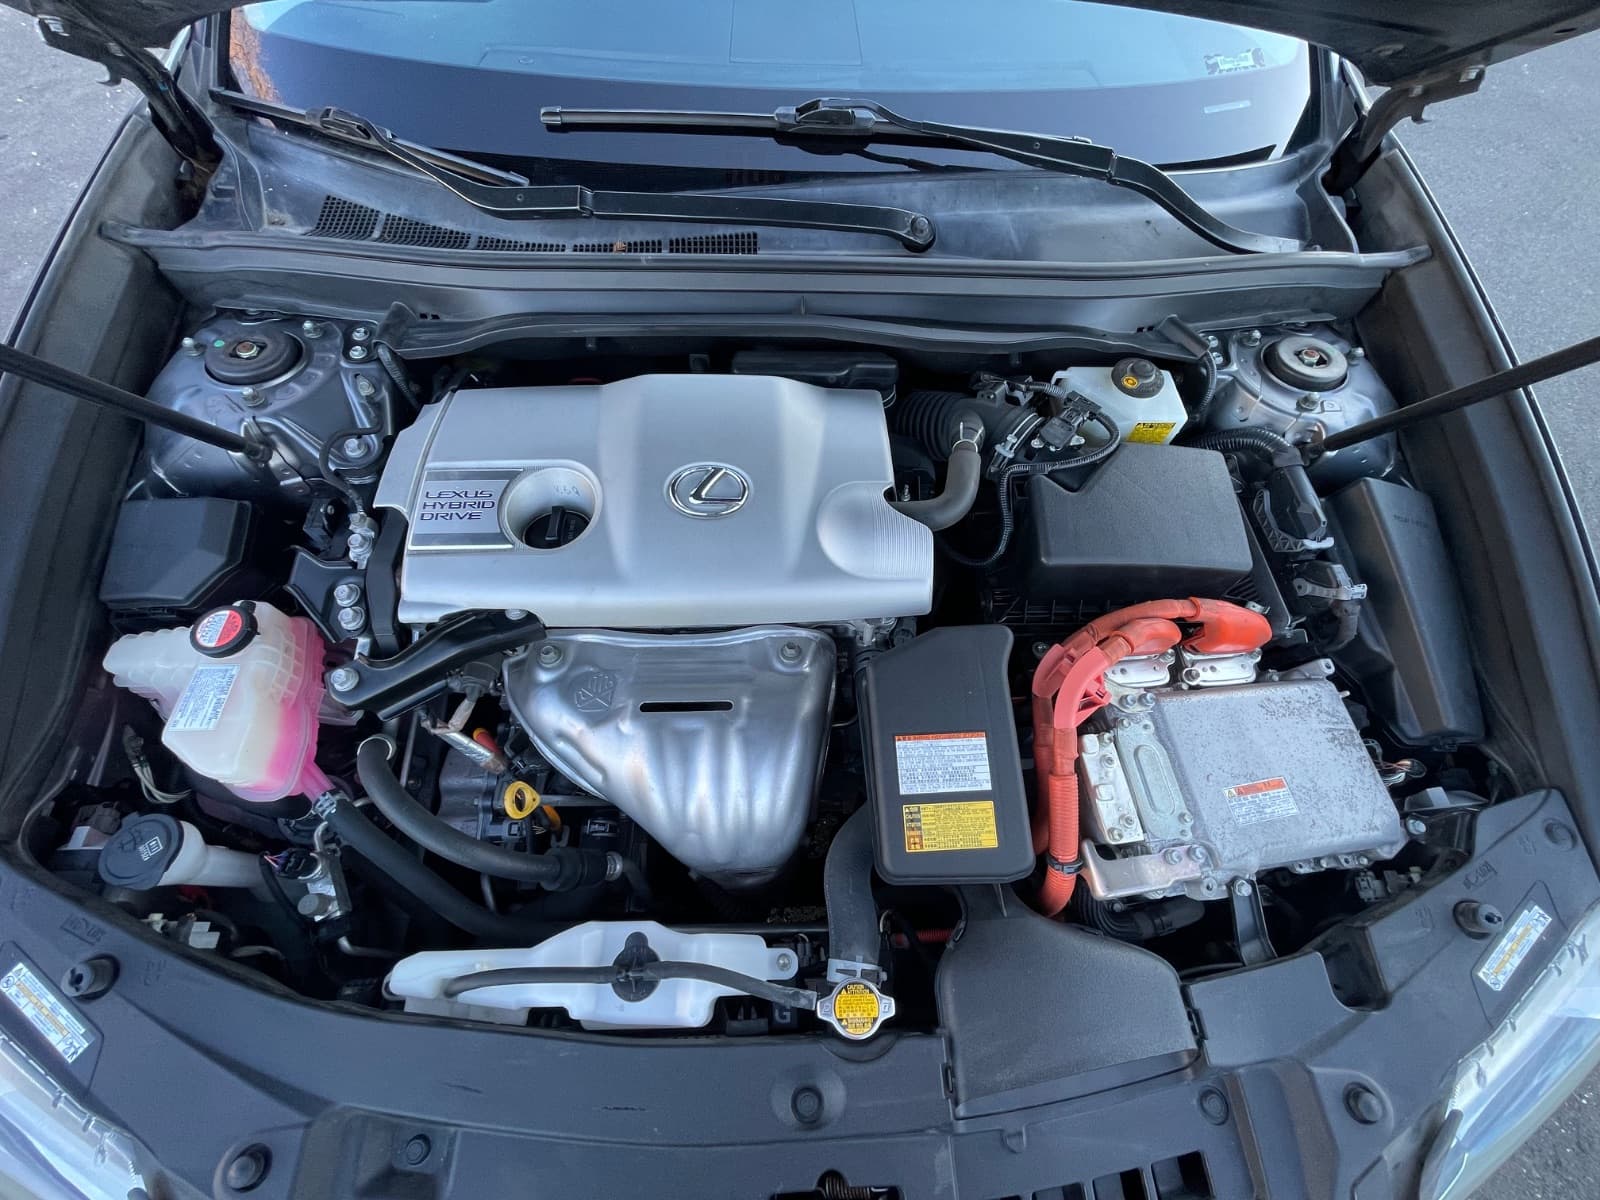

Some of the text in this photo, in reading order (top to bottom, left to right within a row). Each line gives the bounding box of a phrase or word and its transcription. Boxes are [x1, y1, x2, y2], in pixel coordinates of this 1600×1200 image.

[425, 490, 494, 499] LEXUS
[422, 500, 496, 510] HYBRID
[420, 512, 483, 521] DRIVE
